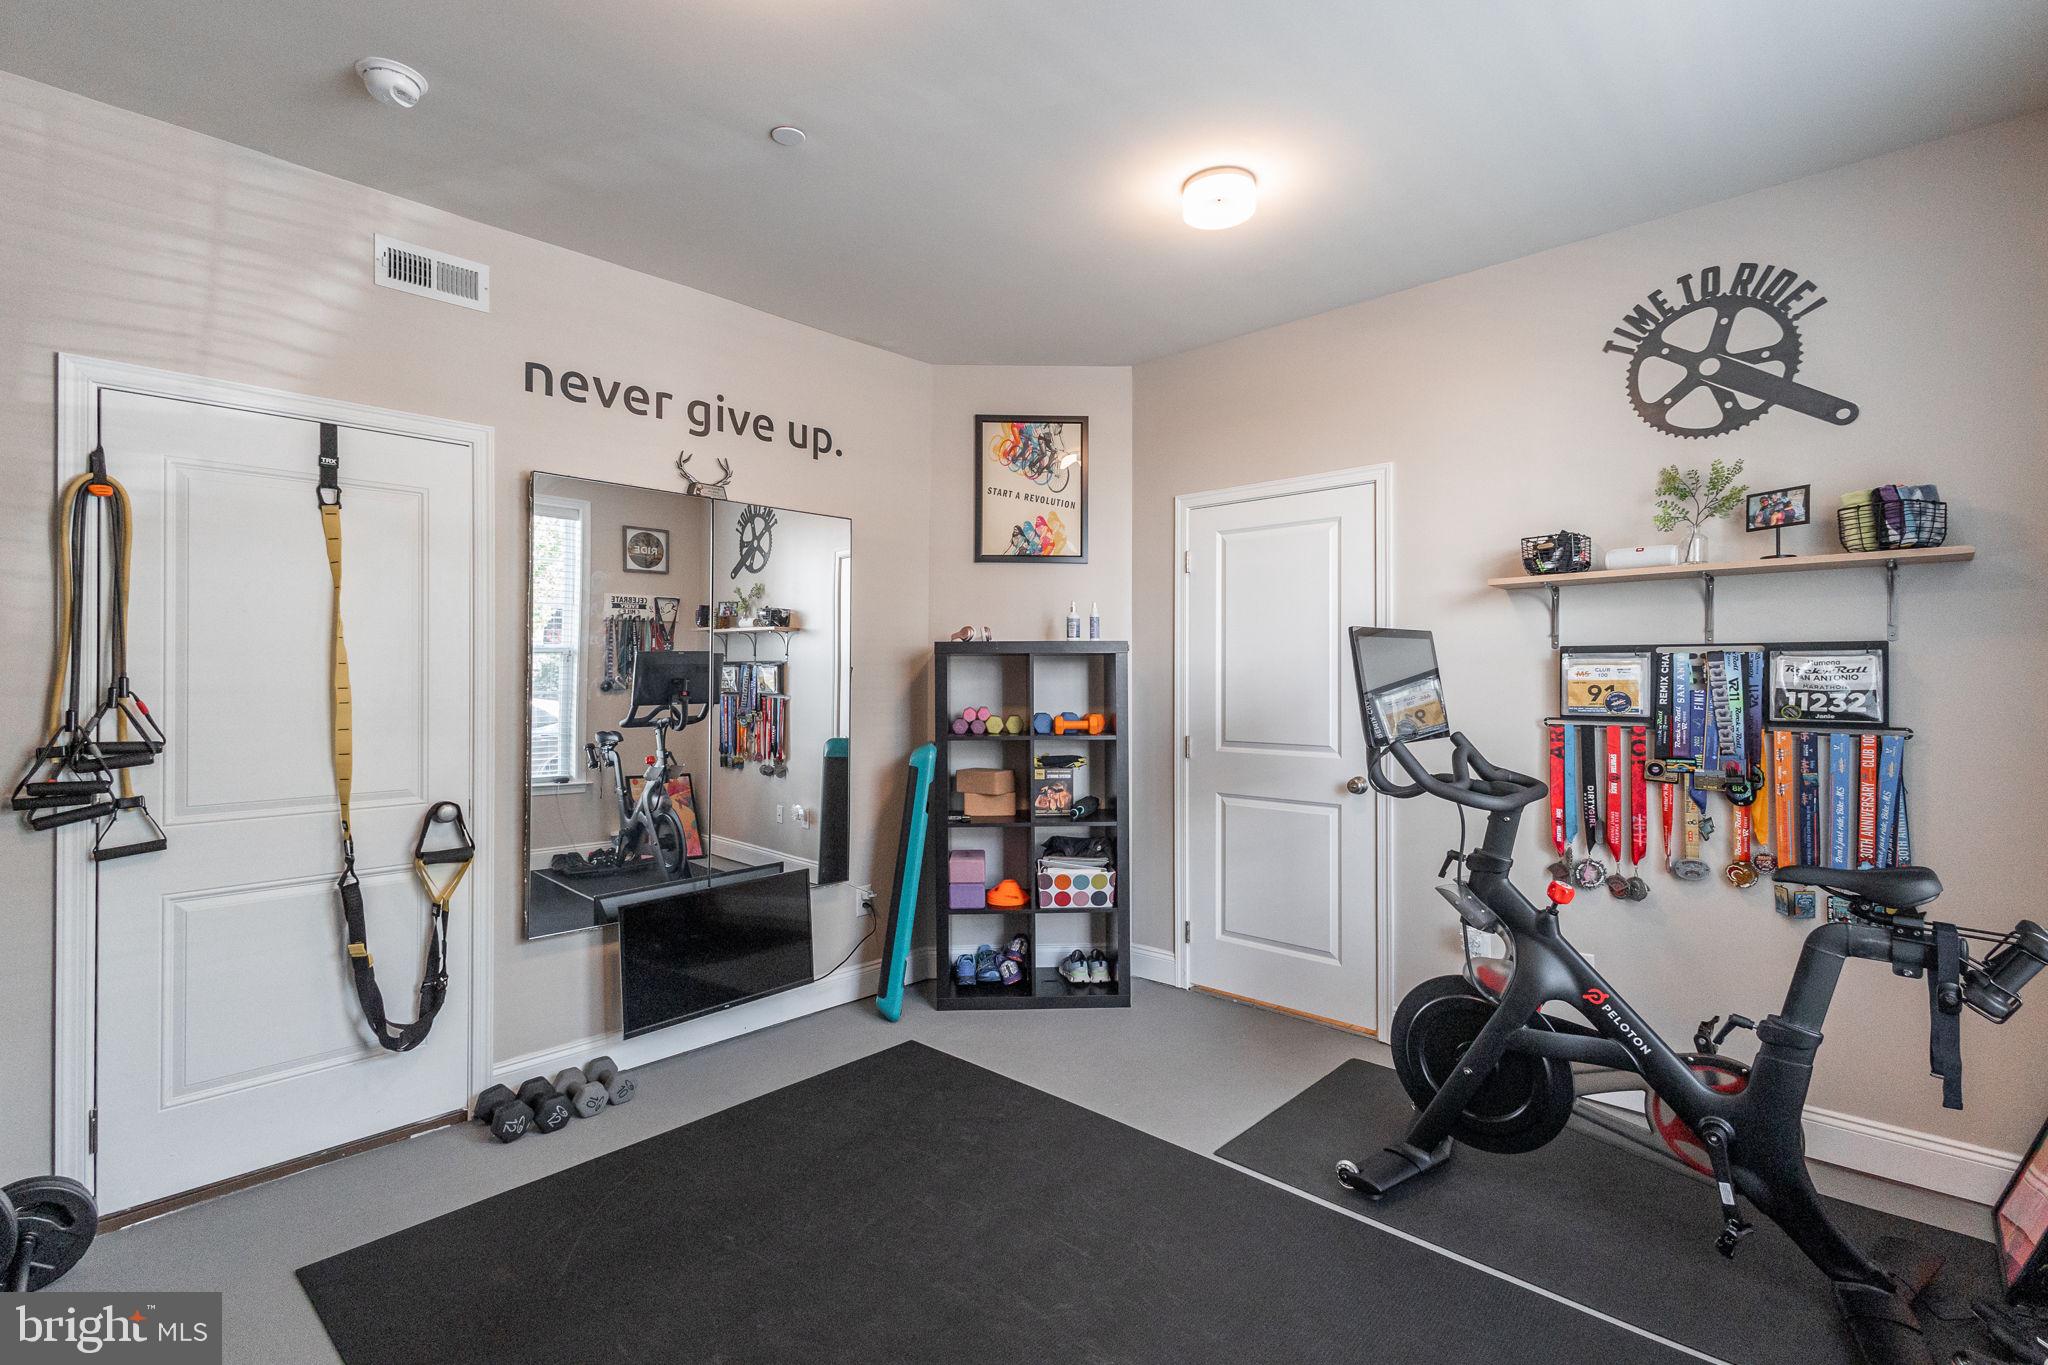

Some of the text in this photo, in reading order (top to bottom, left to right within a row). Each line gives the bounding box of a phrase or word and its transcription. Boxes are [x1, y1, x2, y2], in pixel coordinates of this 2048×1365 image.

[1602, 262, 1828, 355] TIME TO RIDE!
[524, 360, 843, 459] never give up.
[320, 457, 338, 465] TRX
[987, 486, 1076, 510] START A REVOLUTION
[1813, 674, 1859, 682] ANTONIO
[1835, 666, 1868, 674] Roll
[1659, 676, 1669, 705] REMIX
[1677, 684, 1686, 704] SAN
[1786, 691, 1867, 713] 11232
[1674, 706, 1682, 722] Roll
[1550, 724, 1564, 759] AR
[1674, 730, 1682, 748] Rock
[1862, 749, 1874, 768] CLUB
[1732, 784, 1744, 792] 8K
[1883, 791, 1892, 804] MS
[1861, 782, 1875, 837] ANNIVERSARY
[1882, 806, 1890, 820] Bike
[1734, 810, 1742, 828] Roll
[1835, 786, 1845, 863] Don't just ride, Bike MS
[1879, 821, 1888, 836] ride,
[1860, 838, 1874, 859] 30TH
[1877, 835, 1886, 850] just
[1898, 841, 1909, 861] 30TH
[1602, 1004, 1652, 1055] PELOTON
[617, 1085, 629, 1099] 10
[586, 1096, 600, 1110] 10
[502, 1118, 518, 1134] 12
[547, 1112, 562, 1128] 12
